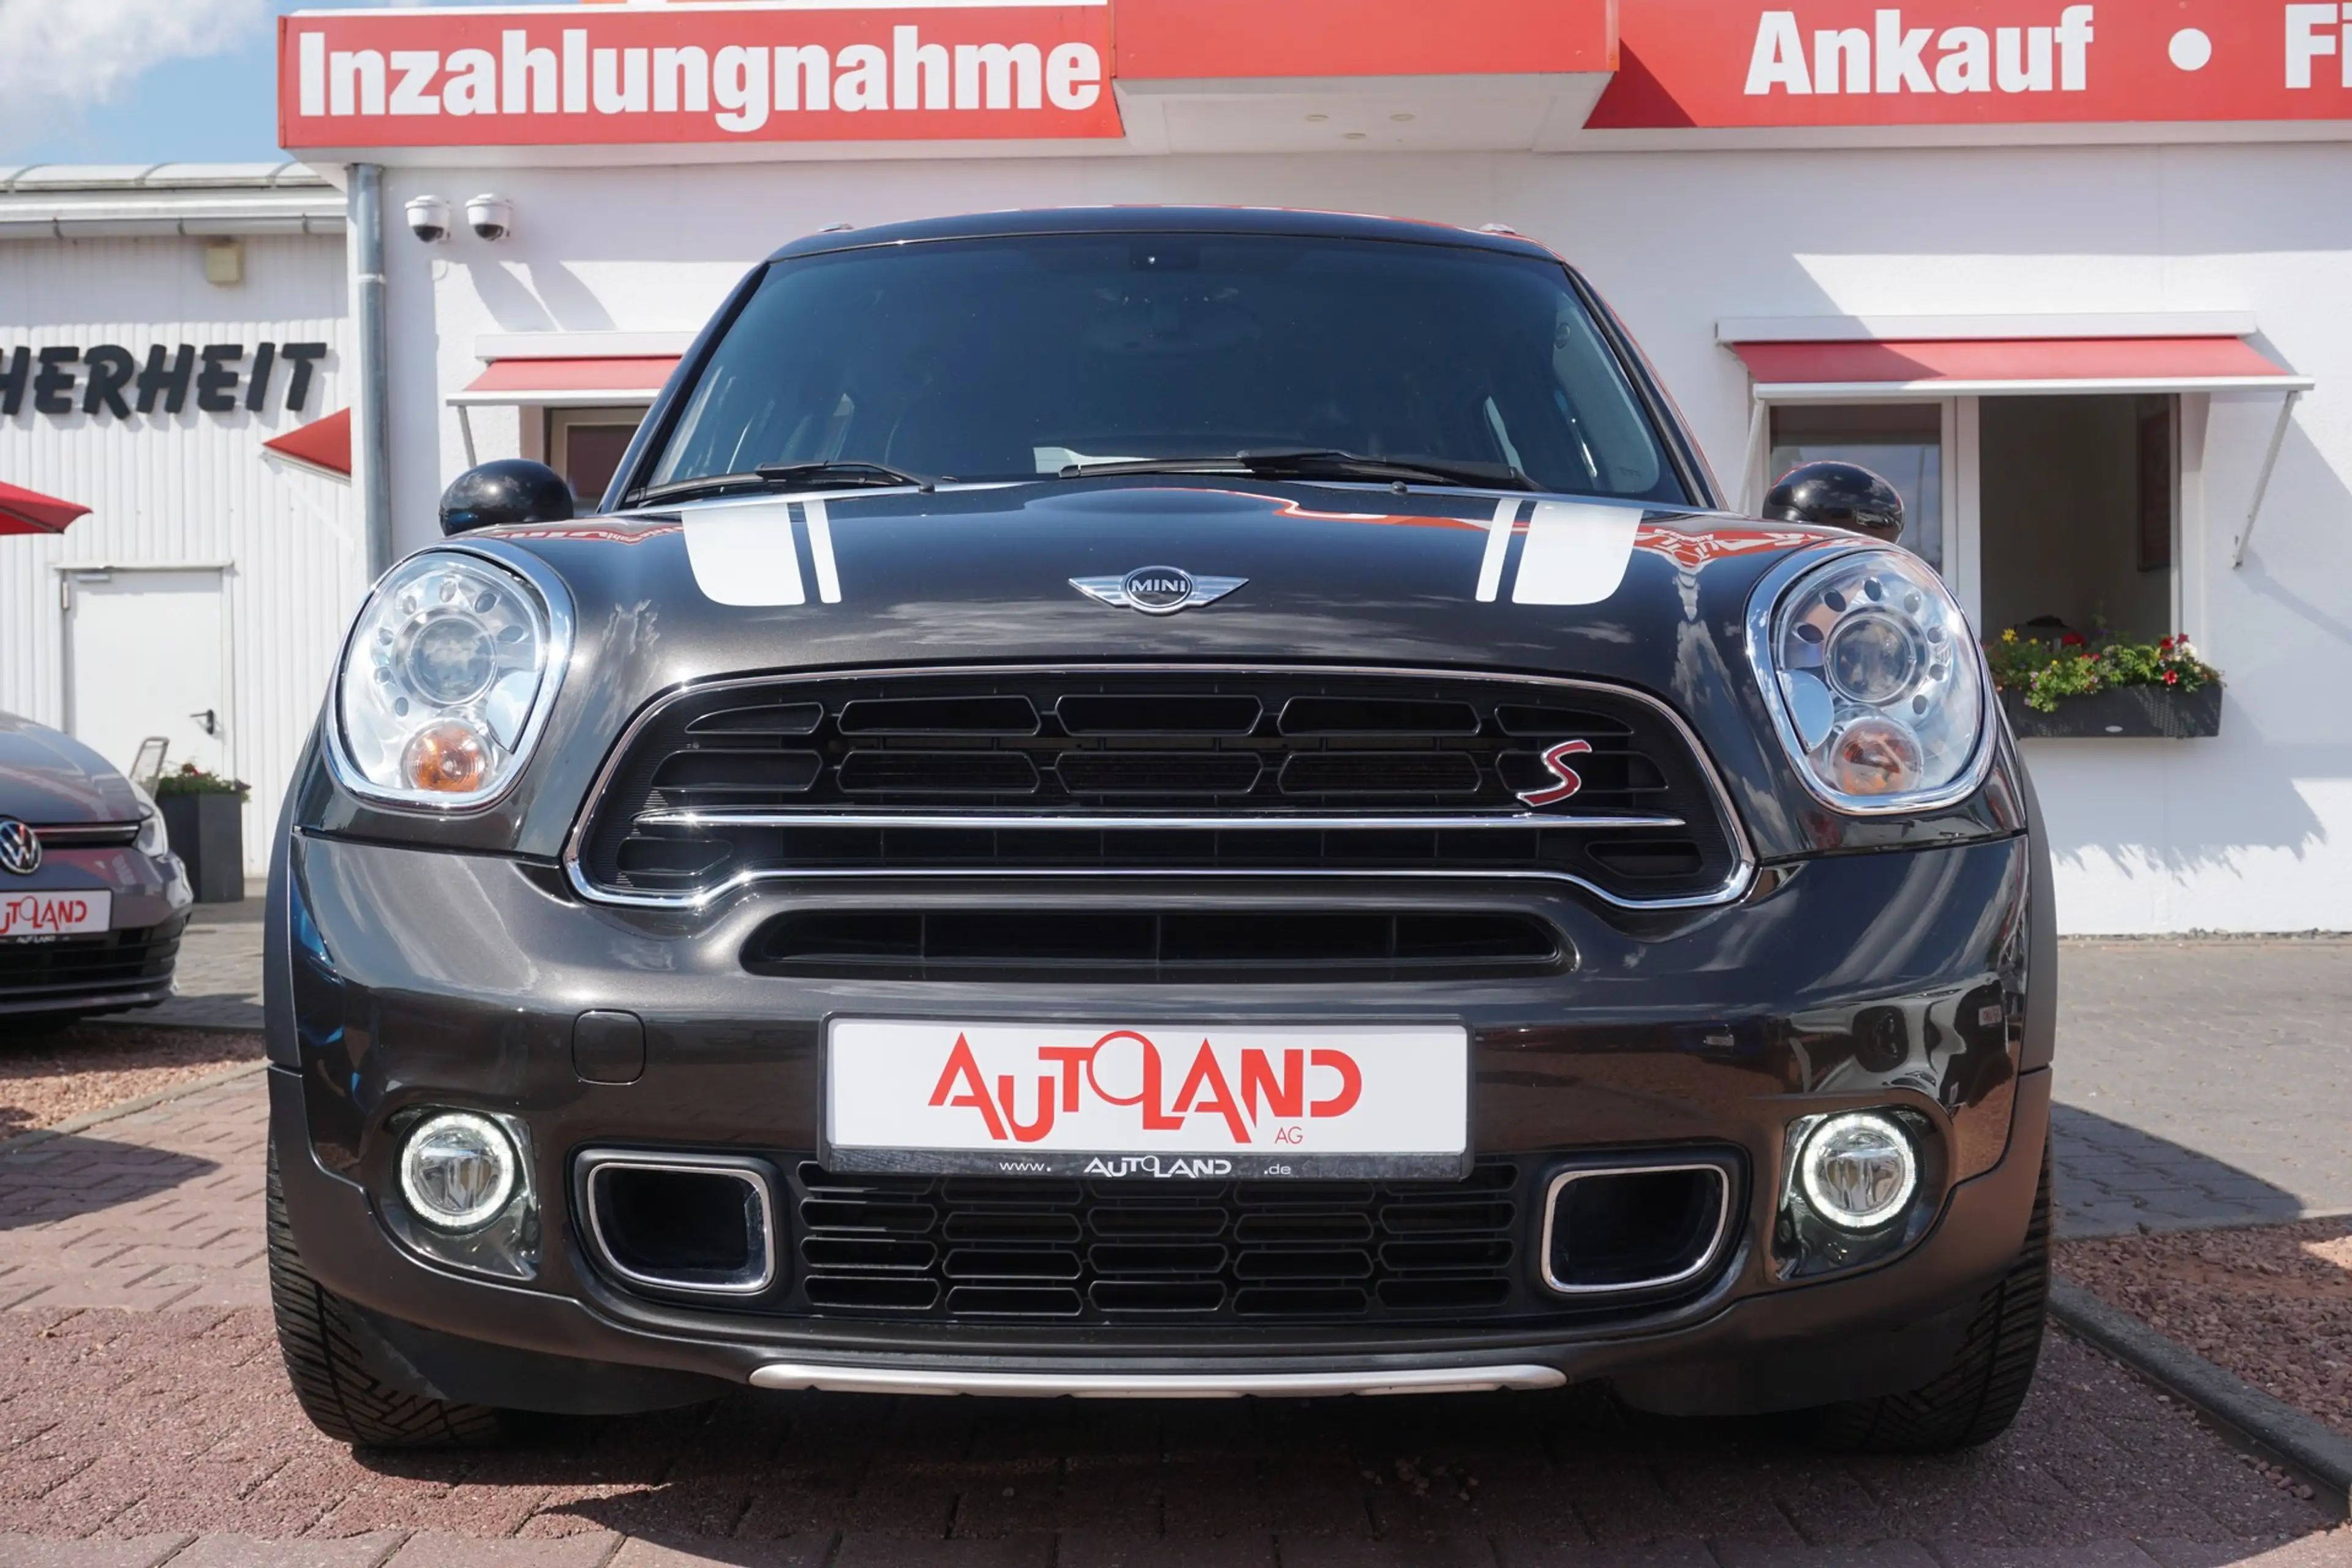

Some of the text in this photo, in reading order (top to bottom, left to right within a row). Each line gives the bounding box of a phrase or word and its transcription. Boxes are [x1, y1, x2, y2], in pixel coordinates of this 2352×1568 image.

[300, 25, 1101, 132] Inzahlungnahme
[1743, 4, 2094, 95] Ankauf
[1131, 579, 1186, 592] MINI
[1515, 739, 1593, 807] S
[928, 1030, 1363, 1144] AUTOLAND
[1000, 1163, 1052, 1172] www.
[1084, 1155, 1232, 1178] AUTOLAND
[1275, 1126, 1303, 1145] AG
